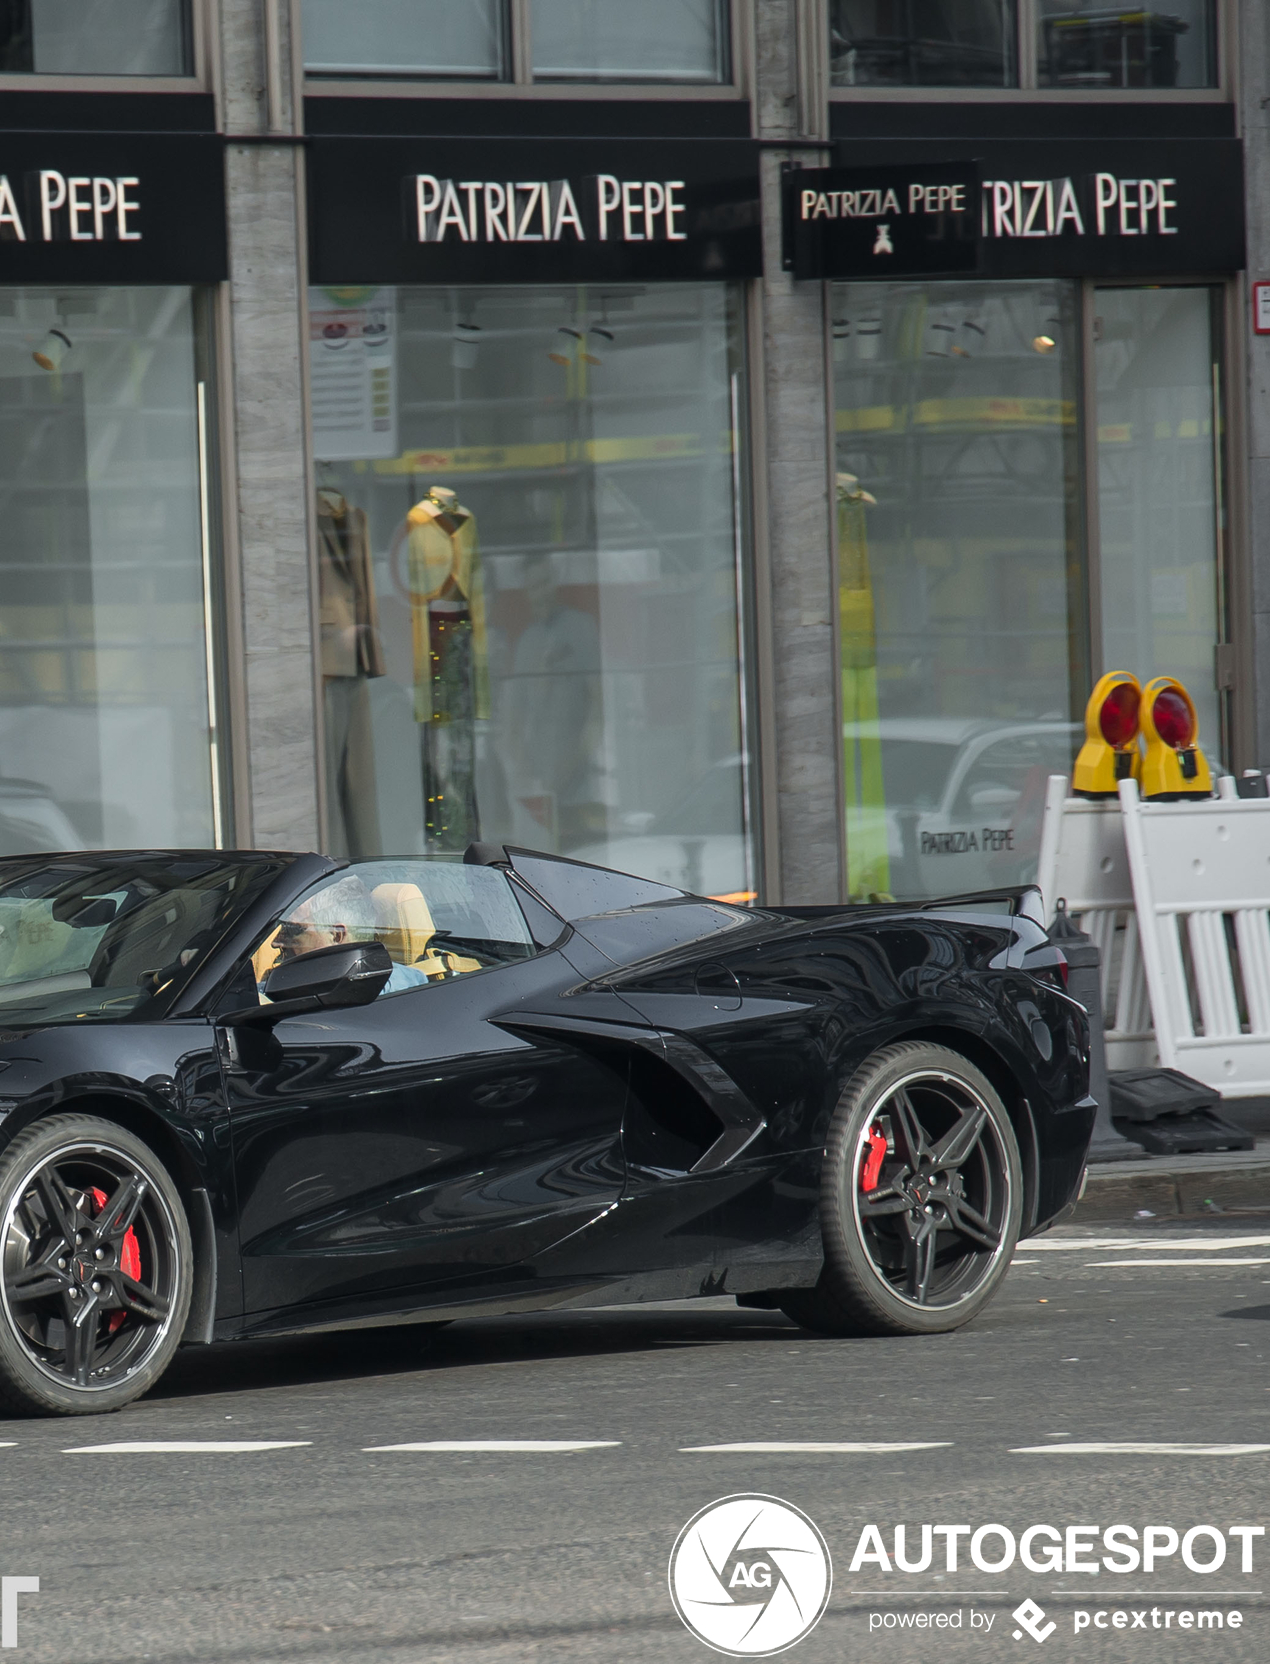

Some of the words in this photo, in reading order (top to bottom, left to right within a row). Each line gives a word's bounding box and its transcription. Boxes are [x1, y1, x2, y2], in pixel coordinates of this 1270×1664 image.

[40, 170, 142, 240] PEPE
[416, 174, 586, 241] PATRIZIA
[597, 174, 687, 241] PEPE
[801, 188, 901, 220] PATRIZIA
[908, 183, 966, 214] PEPE
[1095, 172, 1179, 235] PEPE
[920, 831, 979, 854] PATRIZIA
